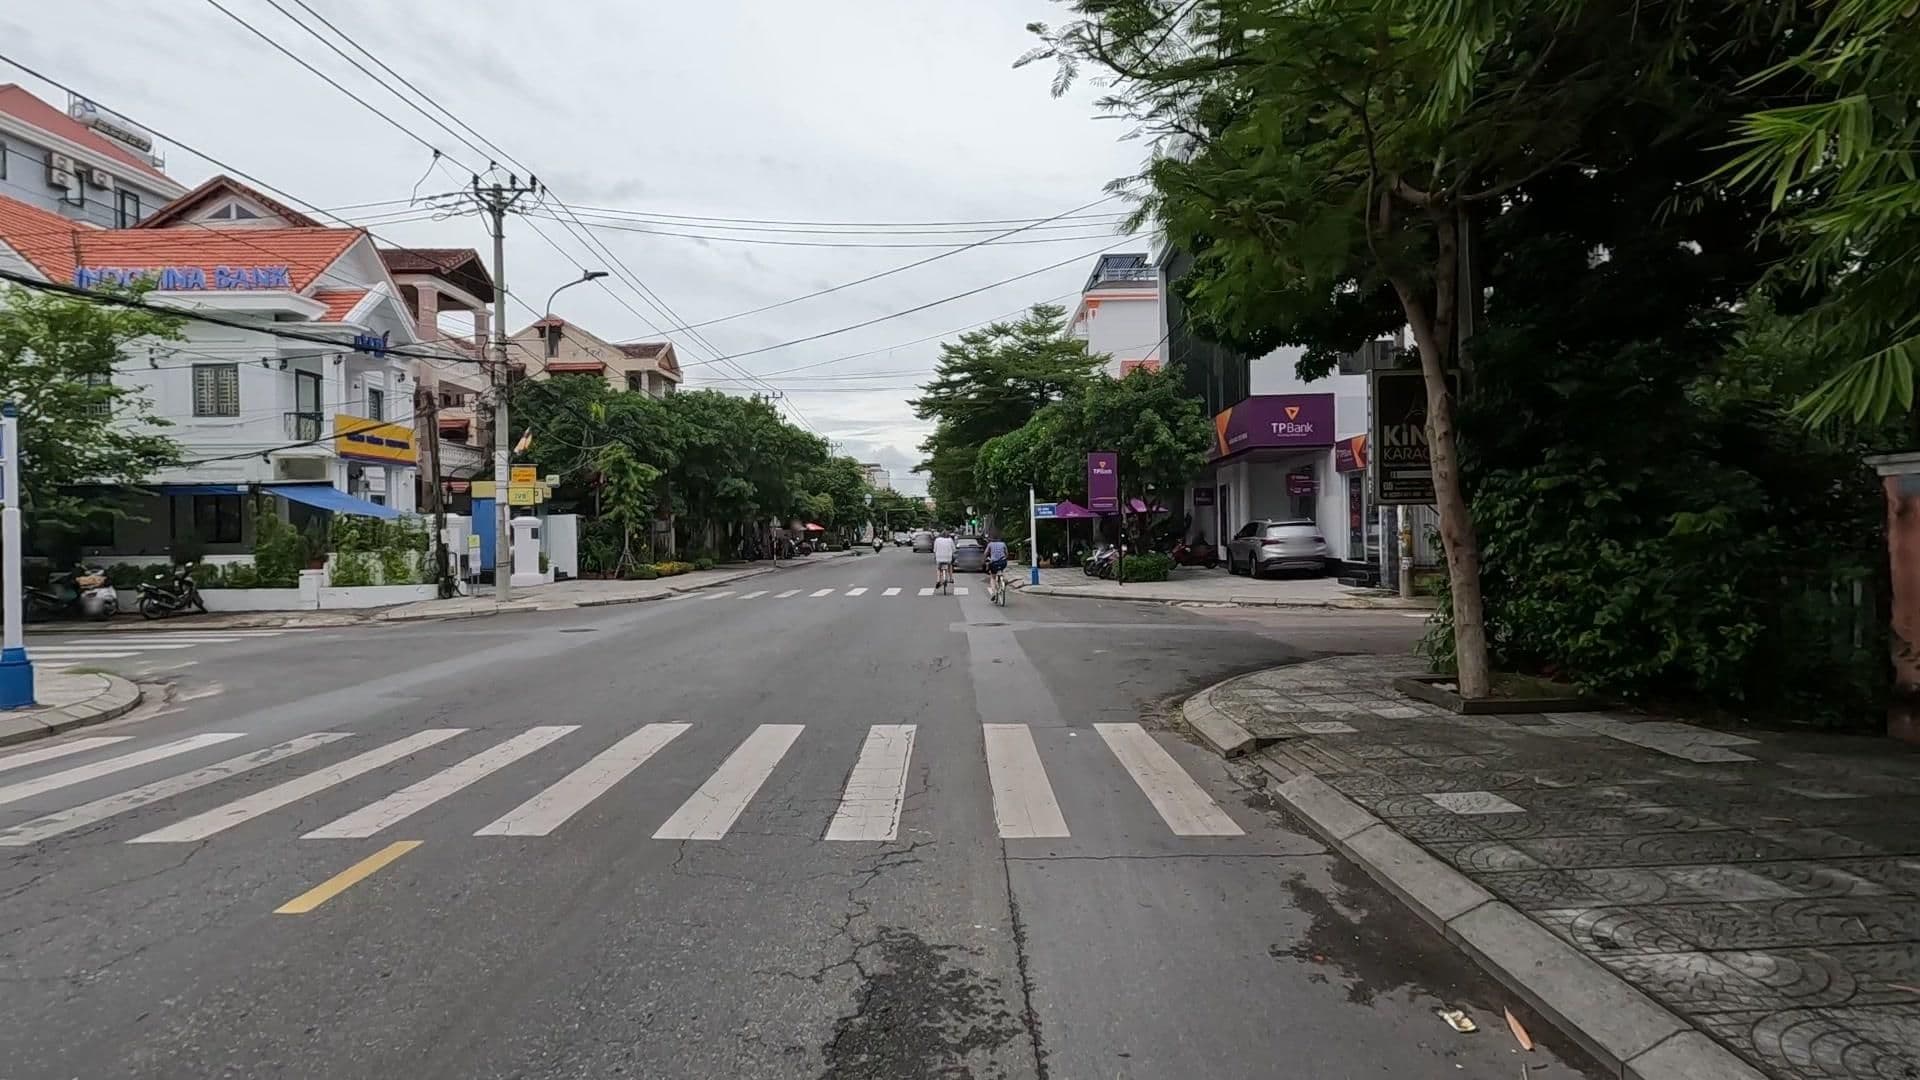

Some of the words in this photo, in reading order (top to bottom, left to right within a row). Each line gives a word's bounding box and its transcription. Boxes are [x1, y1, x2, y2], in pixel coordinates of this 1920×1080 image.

[75, 266, 206, 290] INDOINA
[215, 265, 290, 290] BANK
[1271, 422, 1313, 433] TPBank
